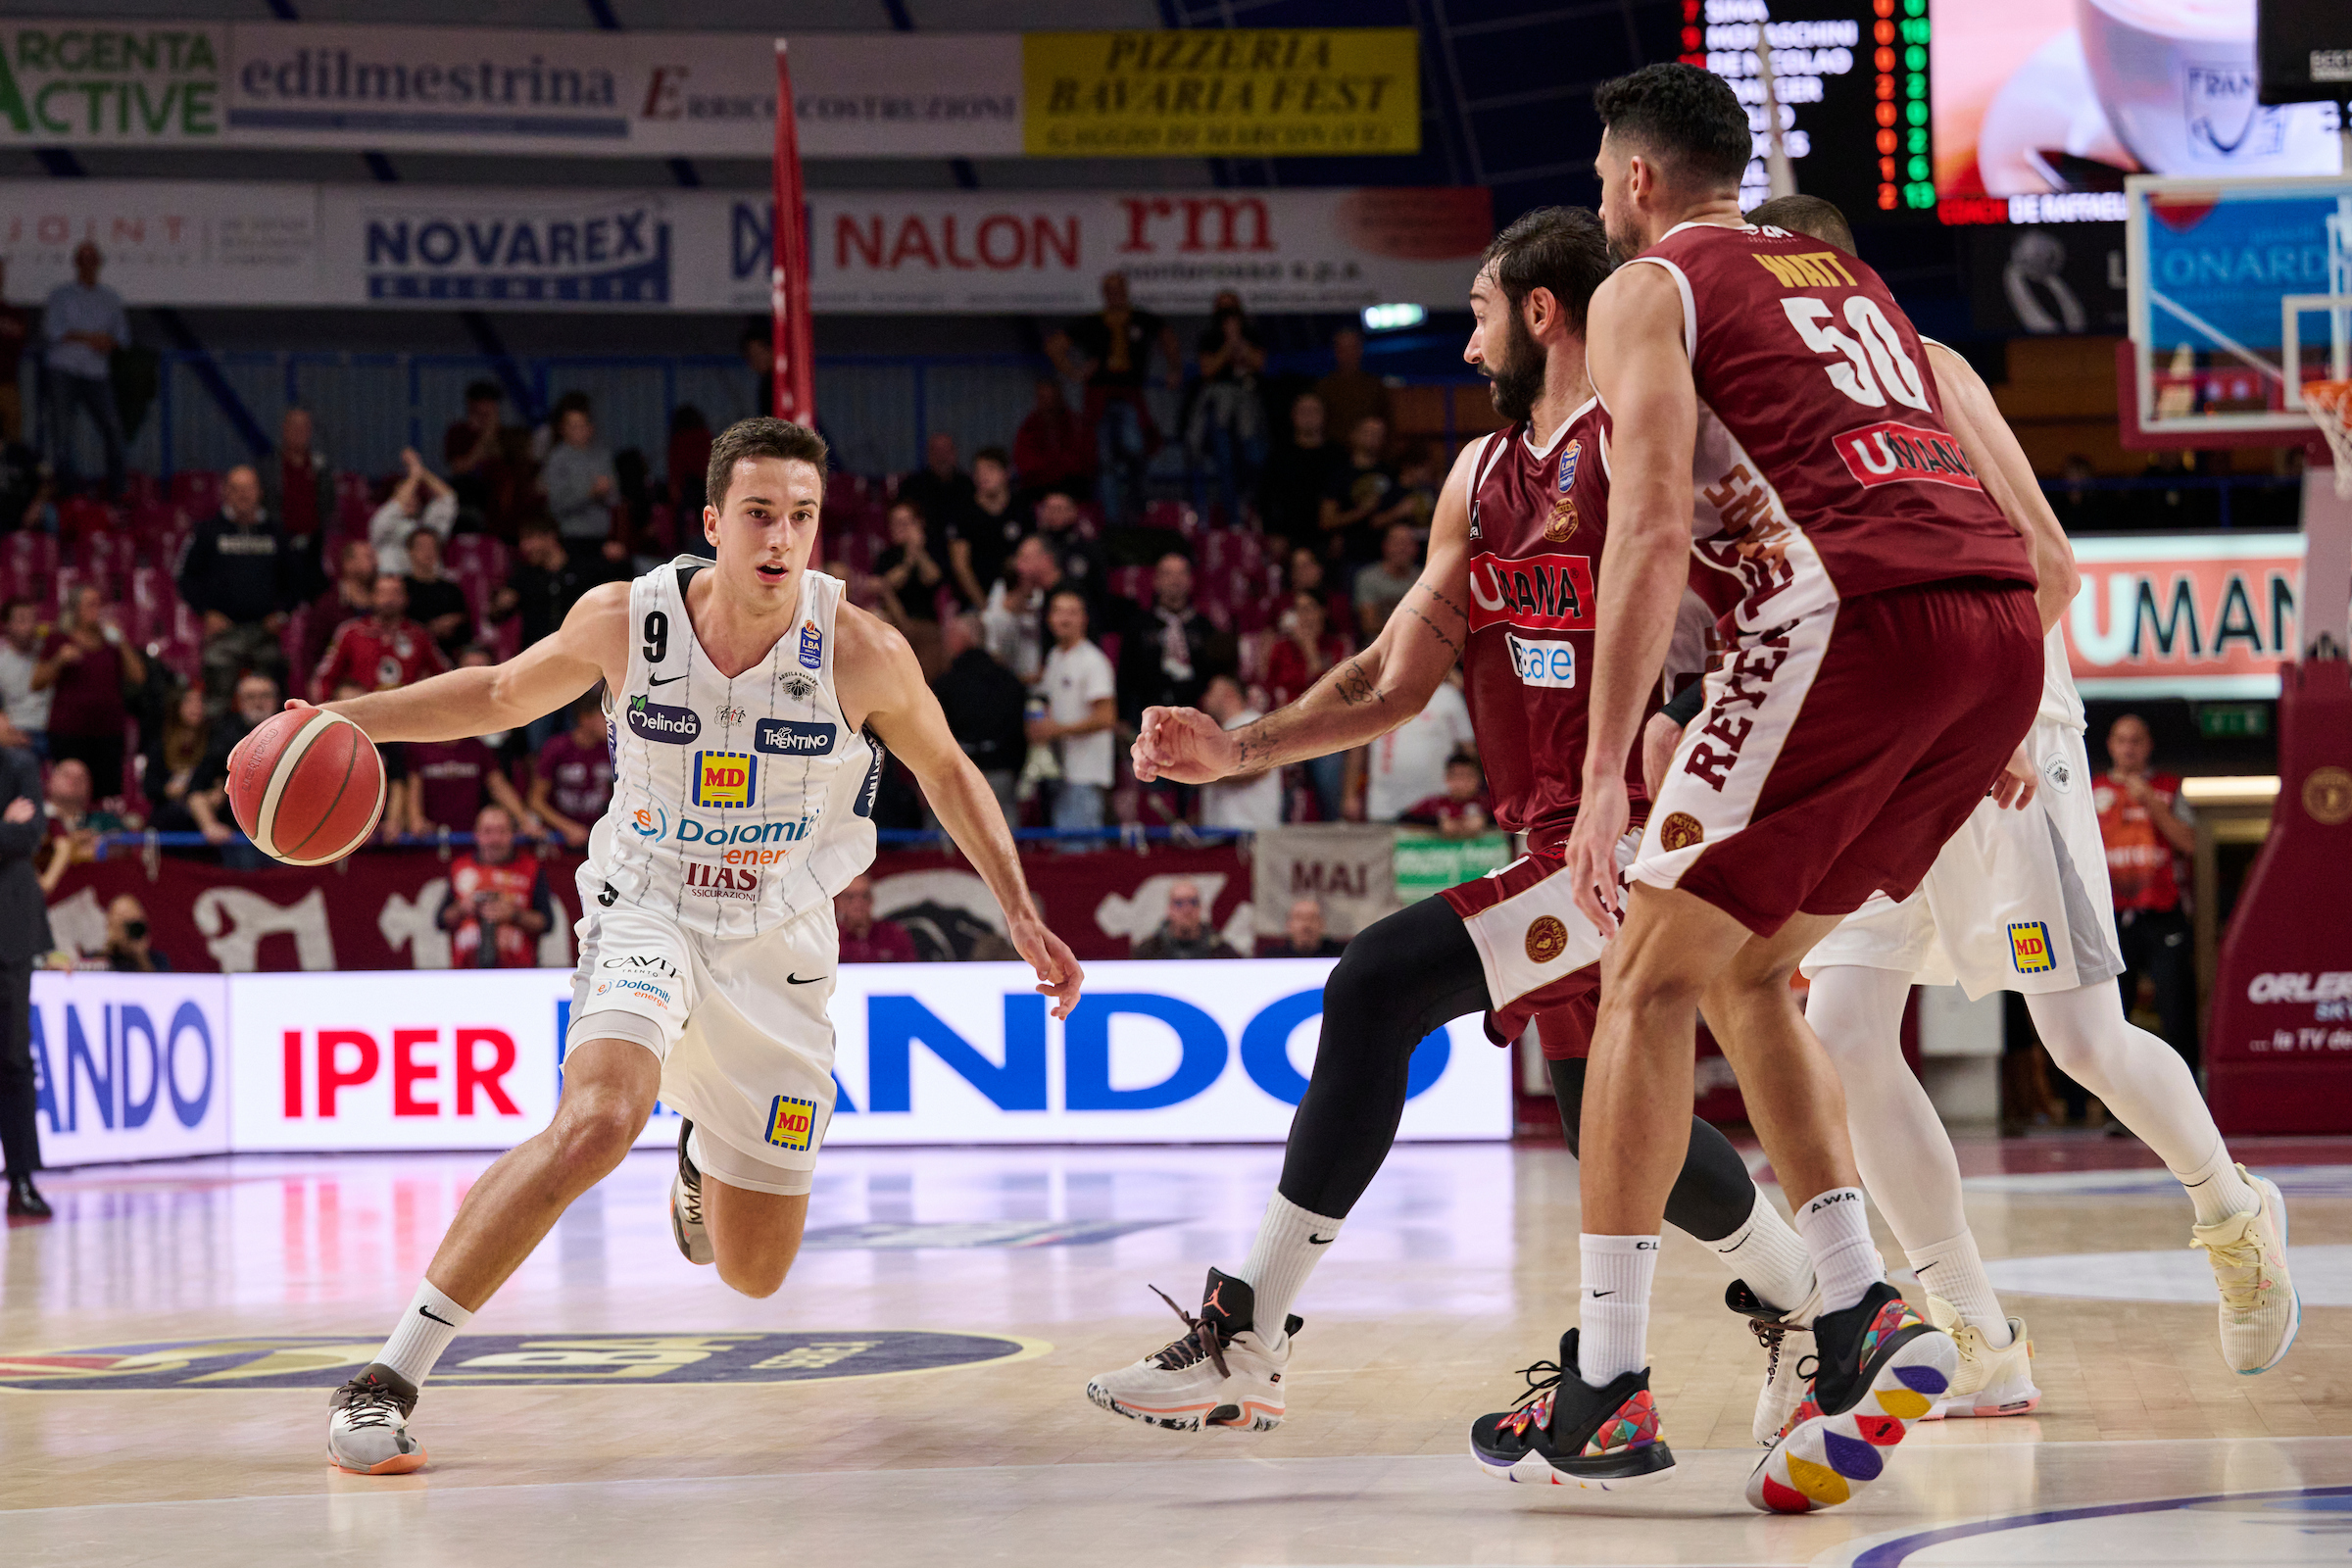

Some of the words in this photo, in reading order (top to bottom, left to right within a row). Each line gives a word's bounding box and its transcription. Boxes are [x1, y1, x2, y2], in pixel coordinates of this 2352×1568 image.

[1104, 34, 1331, 72] PIZZERIA
[241, 49, 615, 107] edilmestrina
[1048, 76, 1256, 116] BAVARIA
[367, 211, 643, 266] NOVAREX
[1119, 196, 1275, 254] rm
[836, 213, 1080, 270] NALON
[1752, 251, 1858, 288] WATT
[1780, 295, 1933, 415] 50
[1471, 563, 1584, 618] UMANA
[643, 611, 668, 663] 9
[803, 638, 820, 652] LBA
[629, 710, 698, 735] Melinda
[763, 728, 829, 751] TRENTINO
[705, 767, 746, 788] MD
[676, 809, 819, 846] Dolomi
[723, 848, 788, 865] ener
[685, 862, 759, 892] ITAS
[2015, 937, 2043, 956] MD
[603, 956, 683, 979] CAVIT
[622, 969, 659, 978] TRENTO
[615, 979, 671, 1004] Dolomiti
[634, 991, 668, 1010] energia
[283, 1028, 521, 1118] IPER
[776, 1111, 809, 1135] MD
[1811, 1192, 1860, 1213] A.W.R.
